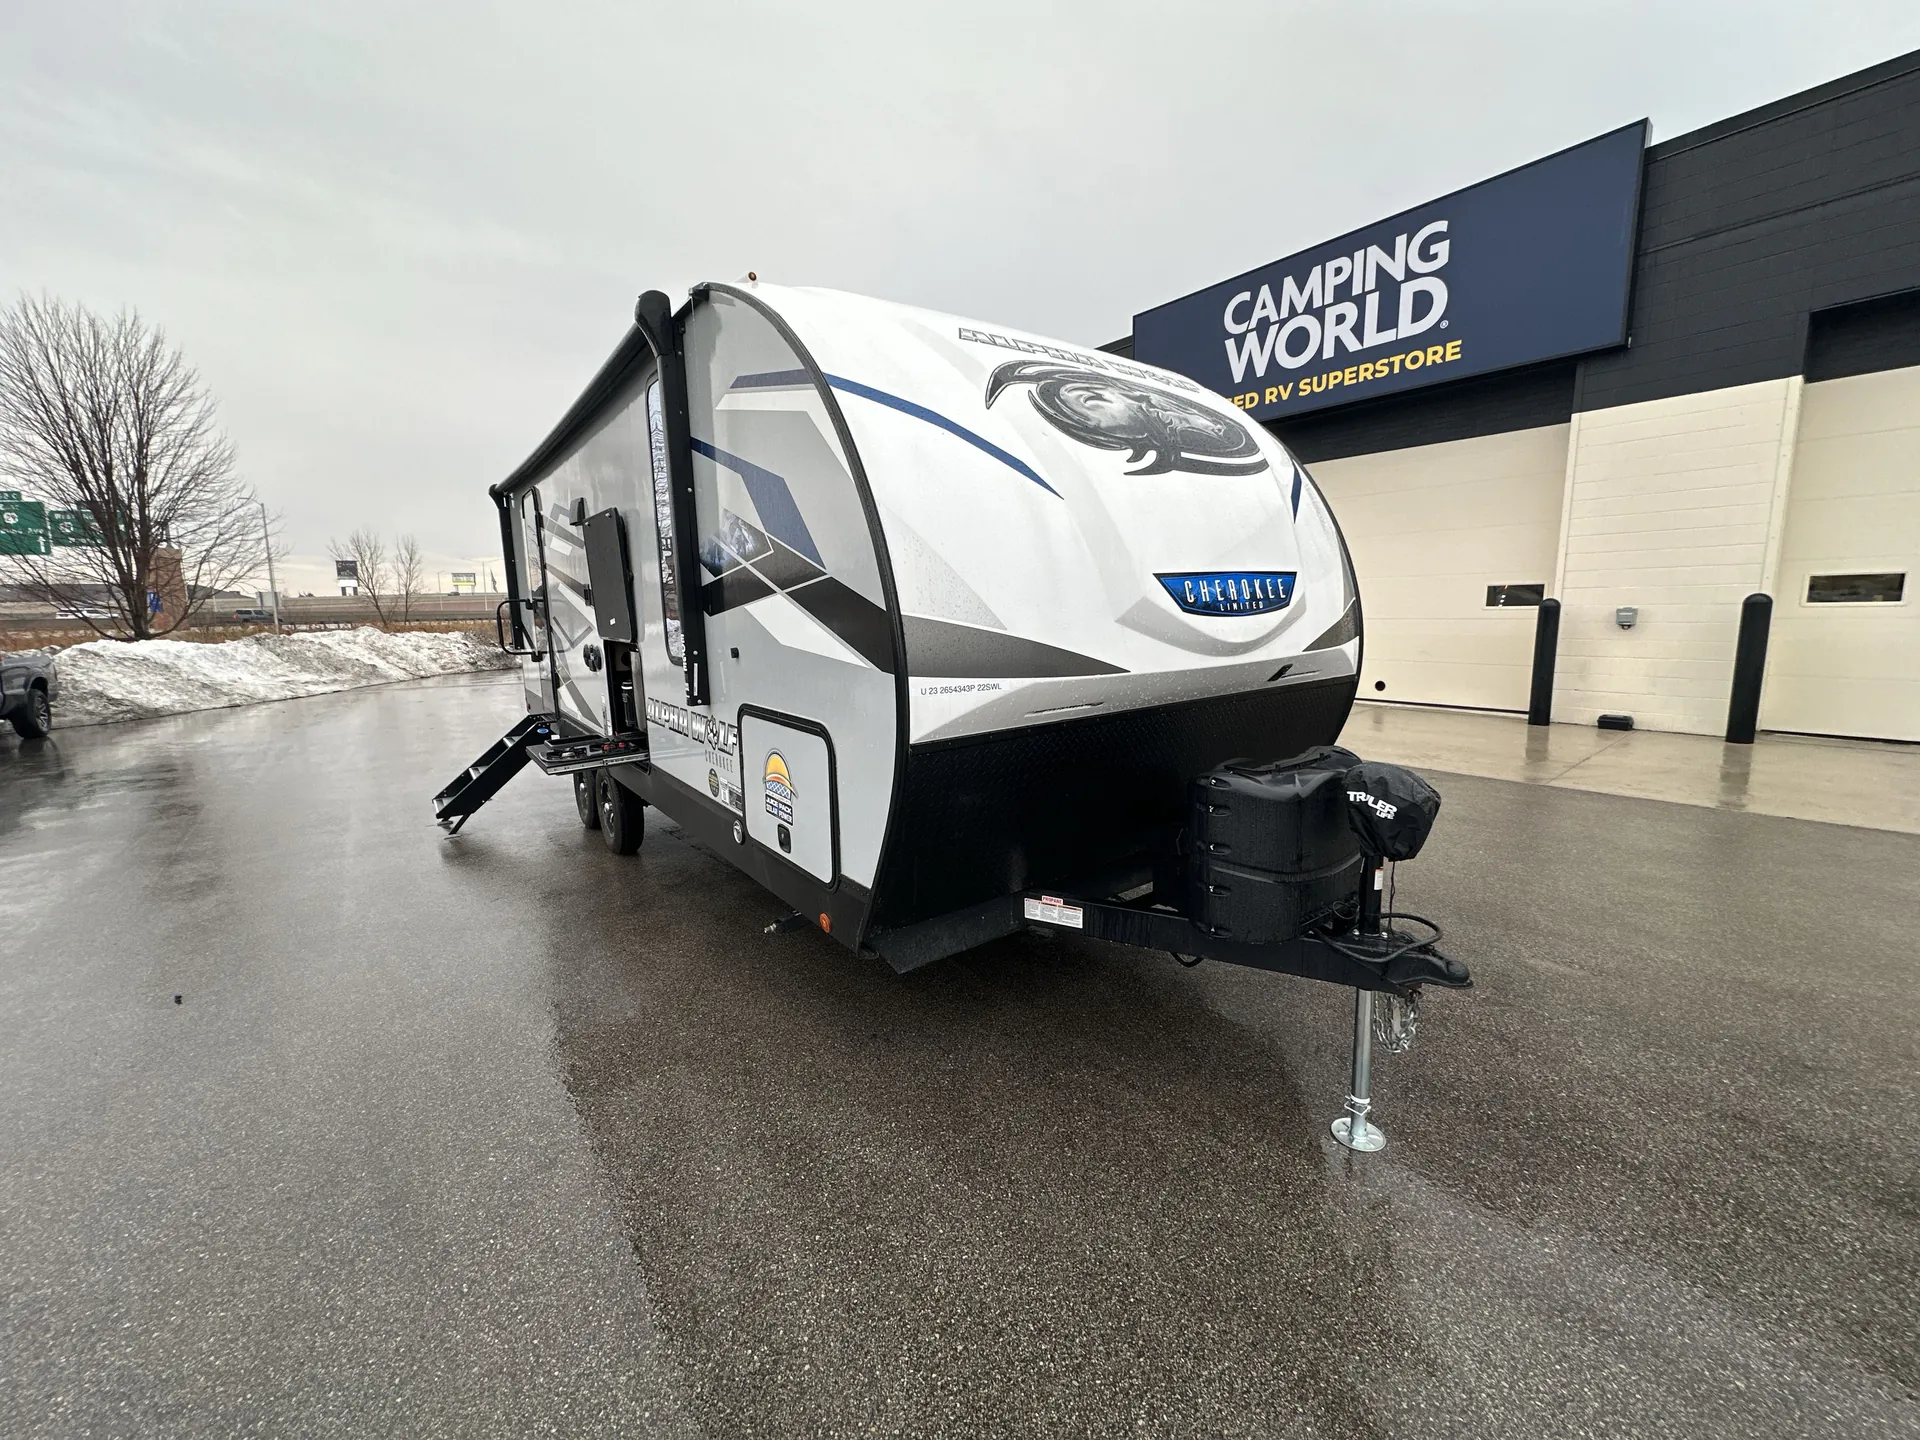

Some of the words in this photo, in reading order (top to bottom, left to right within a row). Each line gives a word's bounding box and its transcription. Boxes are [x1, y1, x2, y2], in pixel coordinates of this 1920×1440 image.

[1223, 219, 1451, 335] CAMPING
[1224, 276, 1449, 384] WORLD
[1226, 391, 1260, 411] ED
[1264, 382, 1294, 405] RV
[1298, 340, 1463, 397] SUPERSTORE
[1184, 578, 1287, 603] CHEROKEE
[1219, 601, 1264, 612] LIMITED
[920, 687, 927, 696] U
[928, 686, 938, 695] 23
[939, 684, 976, 695] 2654343P
[977, 682, 1003, 692] 22SWL
[646, 696, 689, 738] ALPHA
